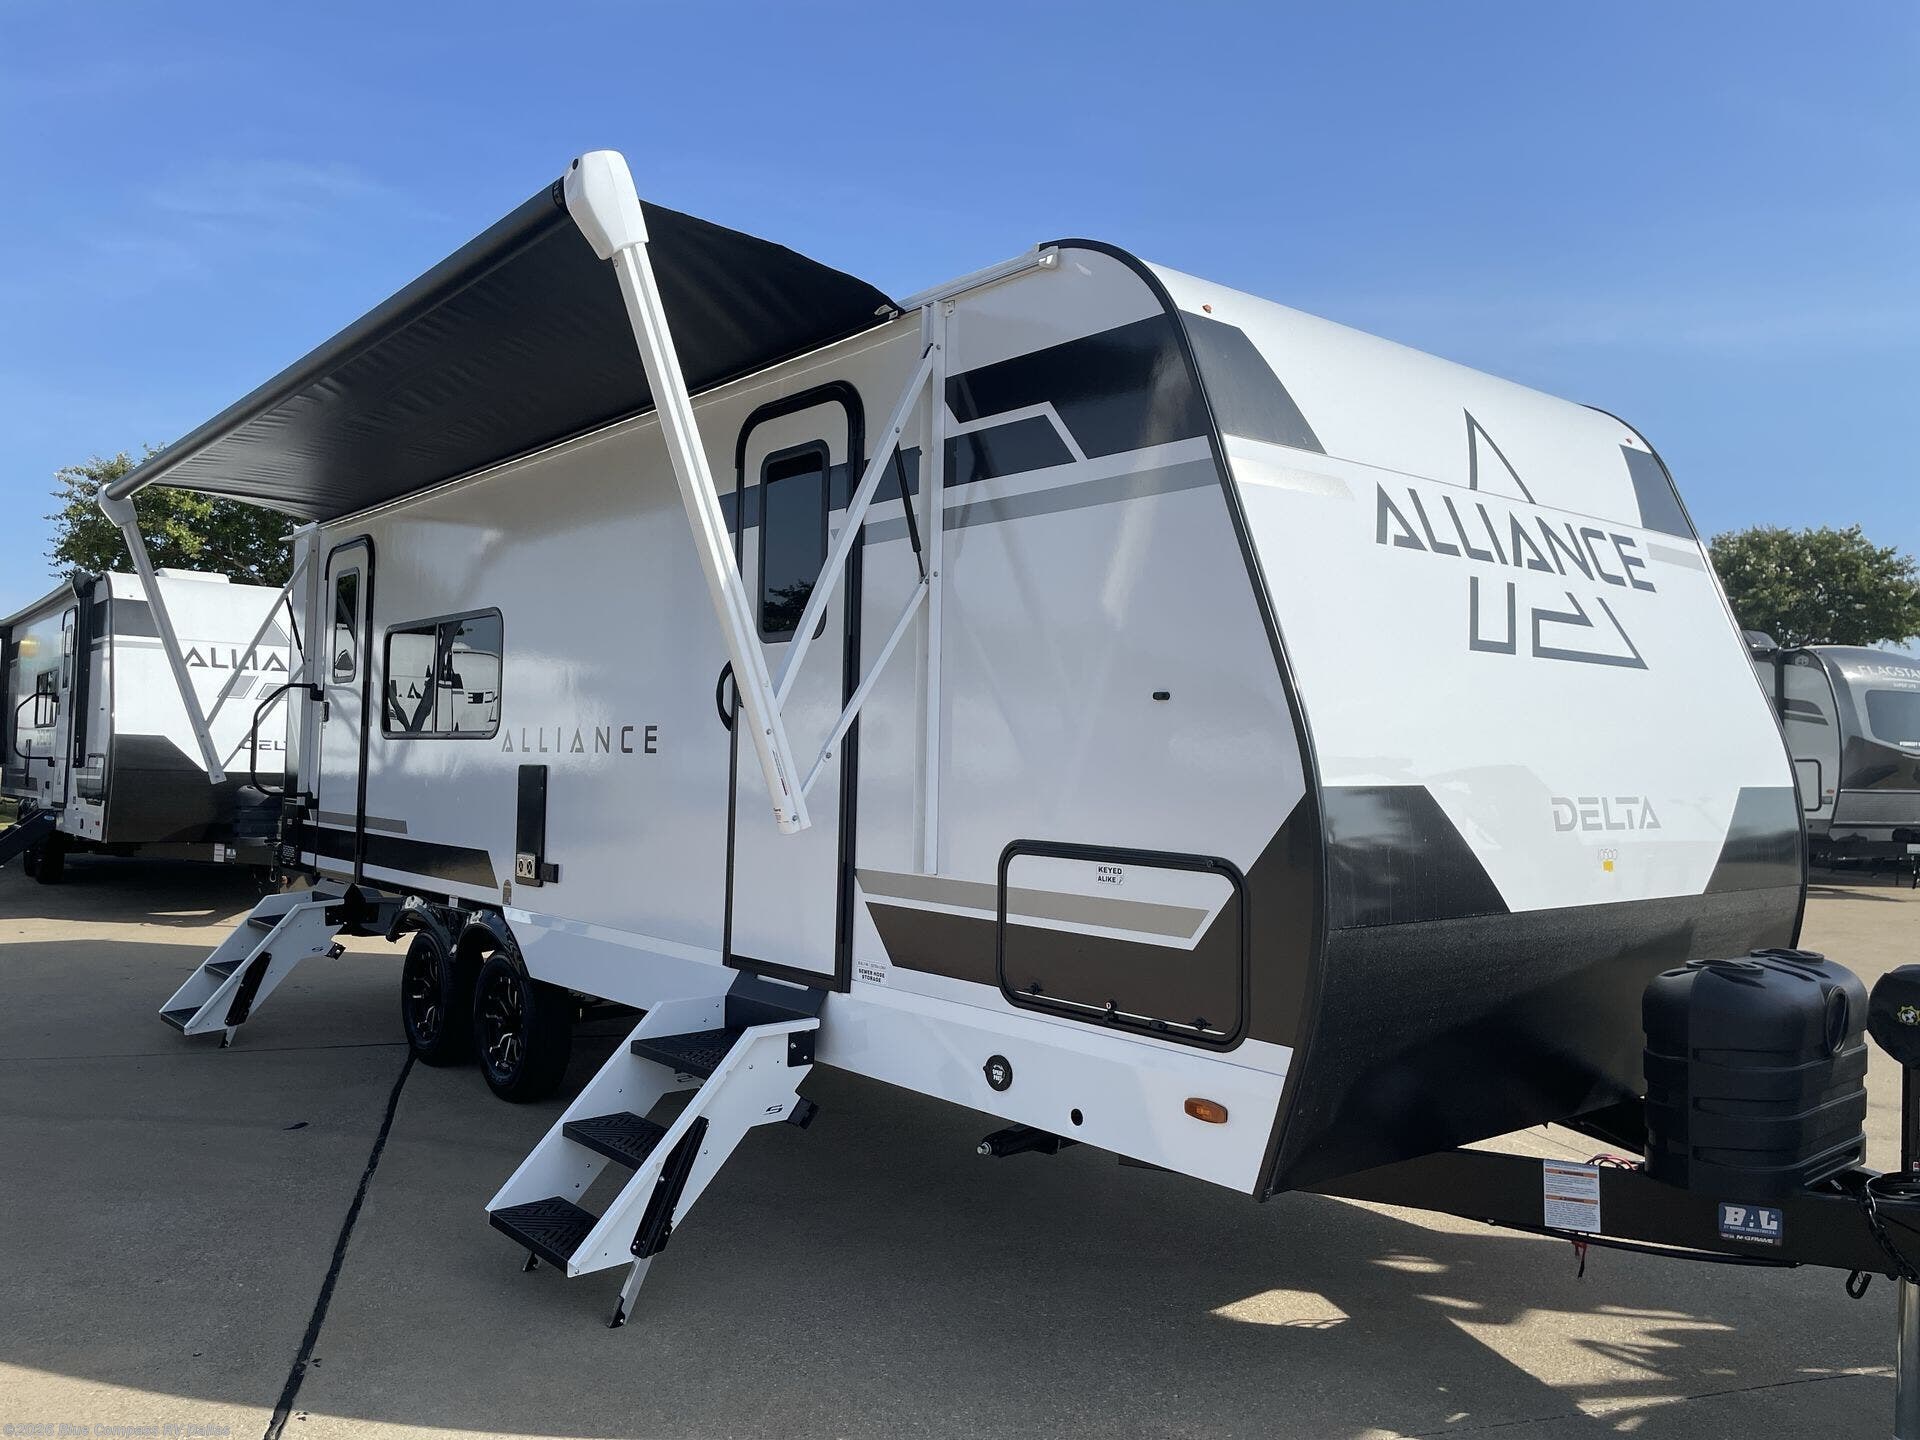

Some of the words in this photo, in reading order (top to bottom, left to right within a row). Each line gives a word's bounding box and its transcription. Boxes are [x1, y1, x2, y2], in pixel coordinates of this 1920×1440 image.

[1376, 481, 1657, 594] ALLIANCE
[1857, 665, 1920, 679] FLAGSTA
[502, 725, 658, 754] ALLIANCE
[1551, 796, 1662, 832] DELTA
[1098, 866, 1122, 875] KEYED
[1098, 875, 1117, 883] ALIKE
